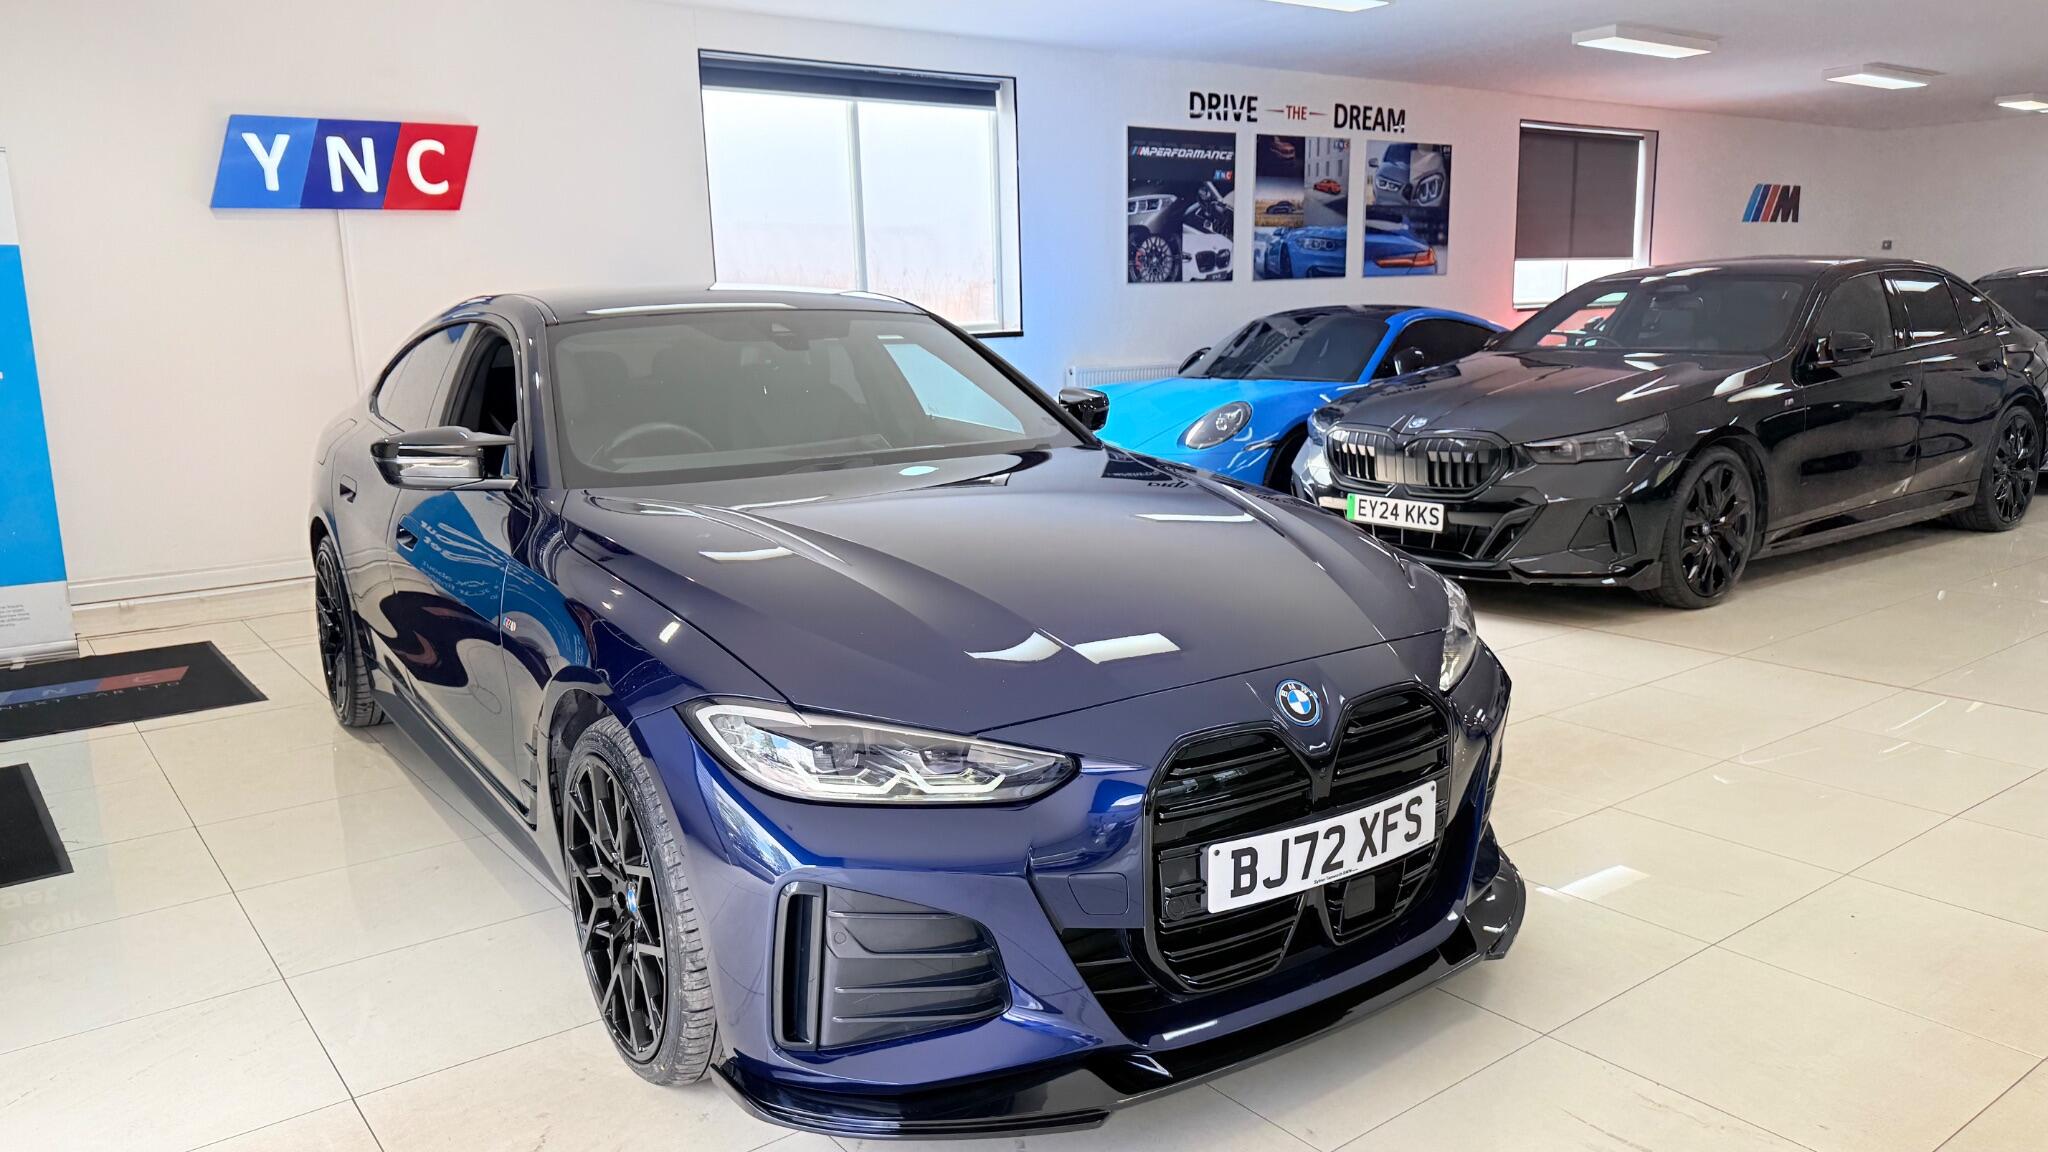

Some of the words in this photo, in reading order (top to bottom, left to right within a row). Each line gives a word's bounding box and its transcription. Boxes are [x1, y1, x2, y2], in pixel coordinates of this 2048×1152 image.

[1189, 91, 1258, 122] DRIVE
[1285, 105, 1308, 120] THE
[1333, 103, 1406, 134] DREAM
[241, 132, 449, 195] YNC
[1358, 498, 1400, 521] EY24
[1405, 504, 1440, 526] KKS
[1230, 824, 1346, 898] BJ72
[1357, 795, 1423, 862] XFS
